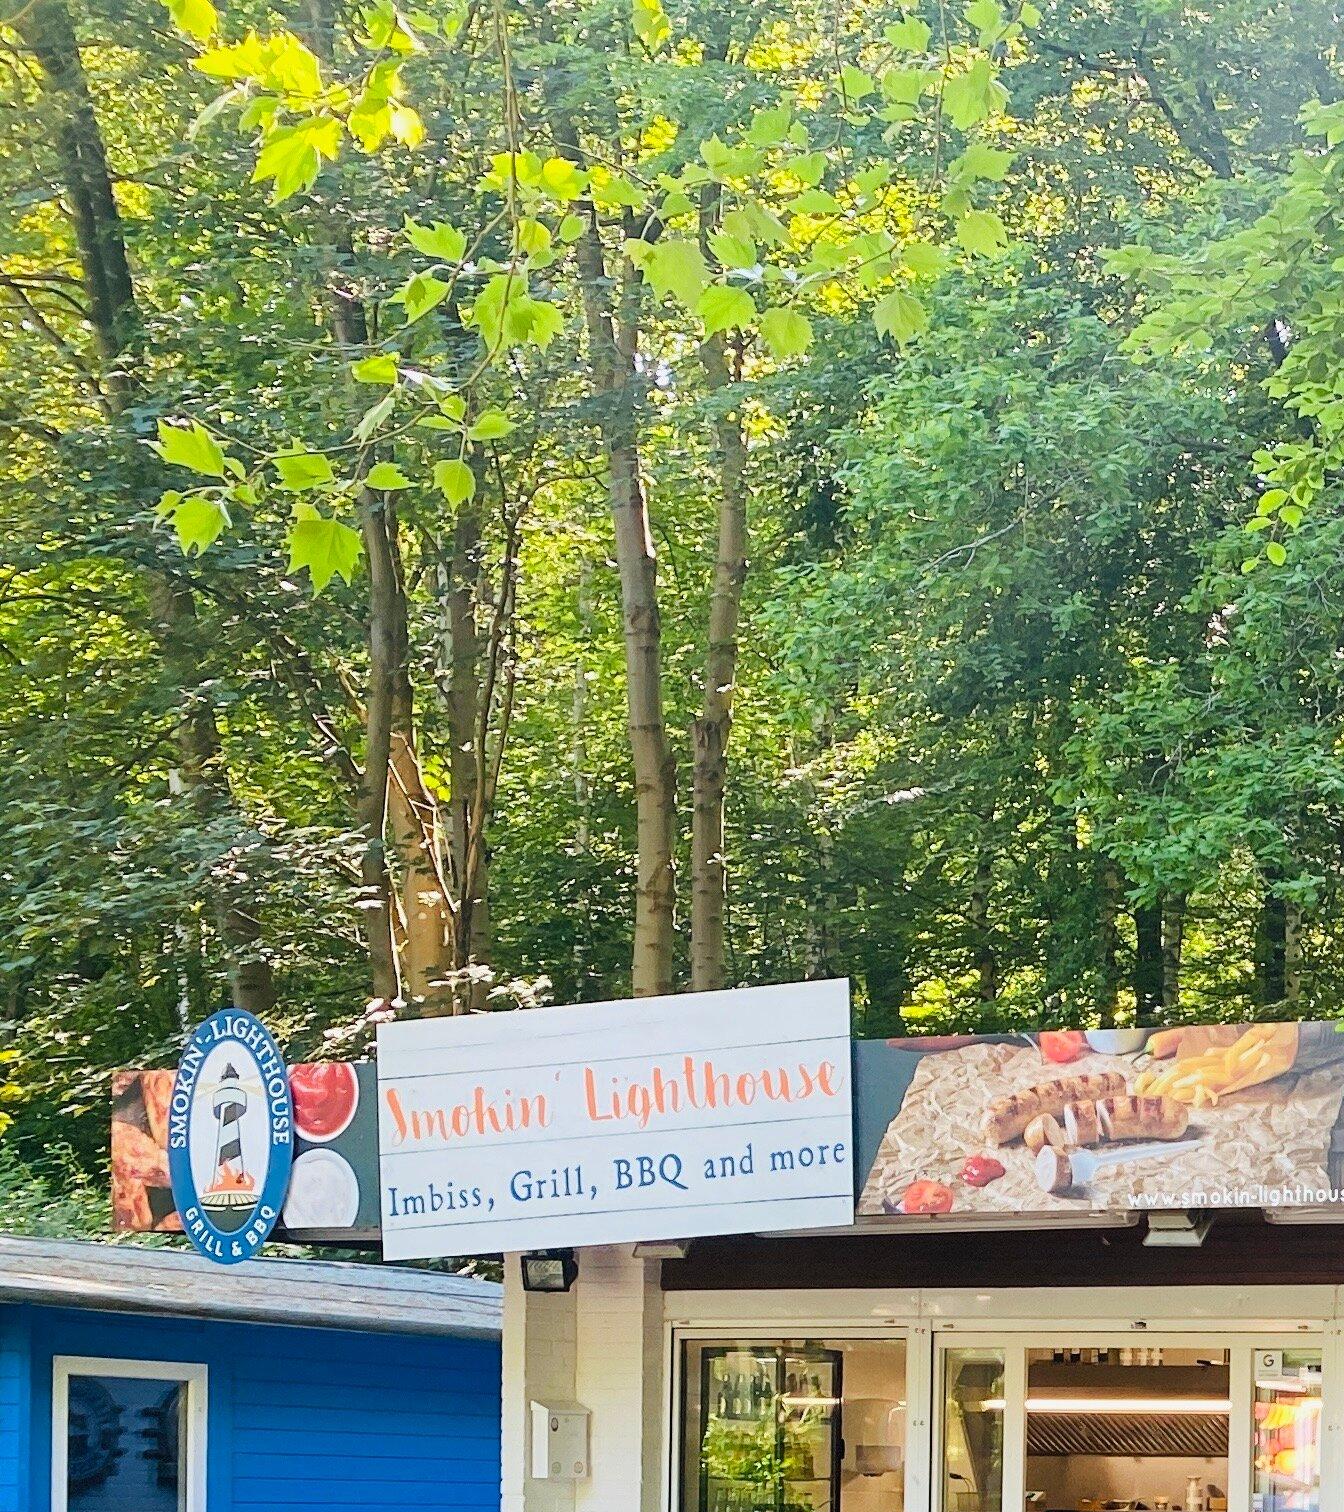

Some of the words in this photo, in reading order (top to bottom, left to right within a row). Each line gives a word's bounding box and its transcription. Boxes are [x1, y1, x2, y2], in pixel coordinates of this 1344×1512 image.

[385, 1070, 561, 1146] Smokin'
[583, 1055, 846, 1129] Lighthouse
[387, 1180, 495, 1217] Imbiss,
[509, 1165, 598, 1201] Grill,
[612, 1152, 690, 1191] BBQ
[703, 1142, 754, 1180] and
[769, 1139, 847, 1172] more
[184, 1206, 224, 1258] GRILL
[231, 1240, 243, 1258] &
[244, 1204, 276, 1247] BBQ
